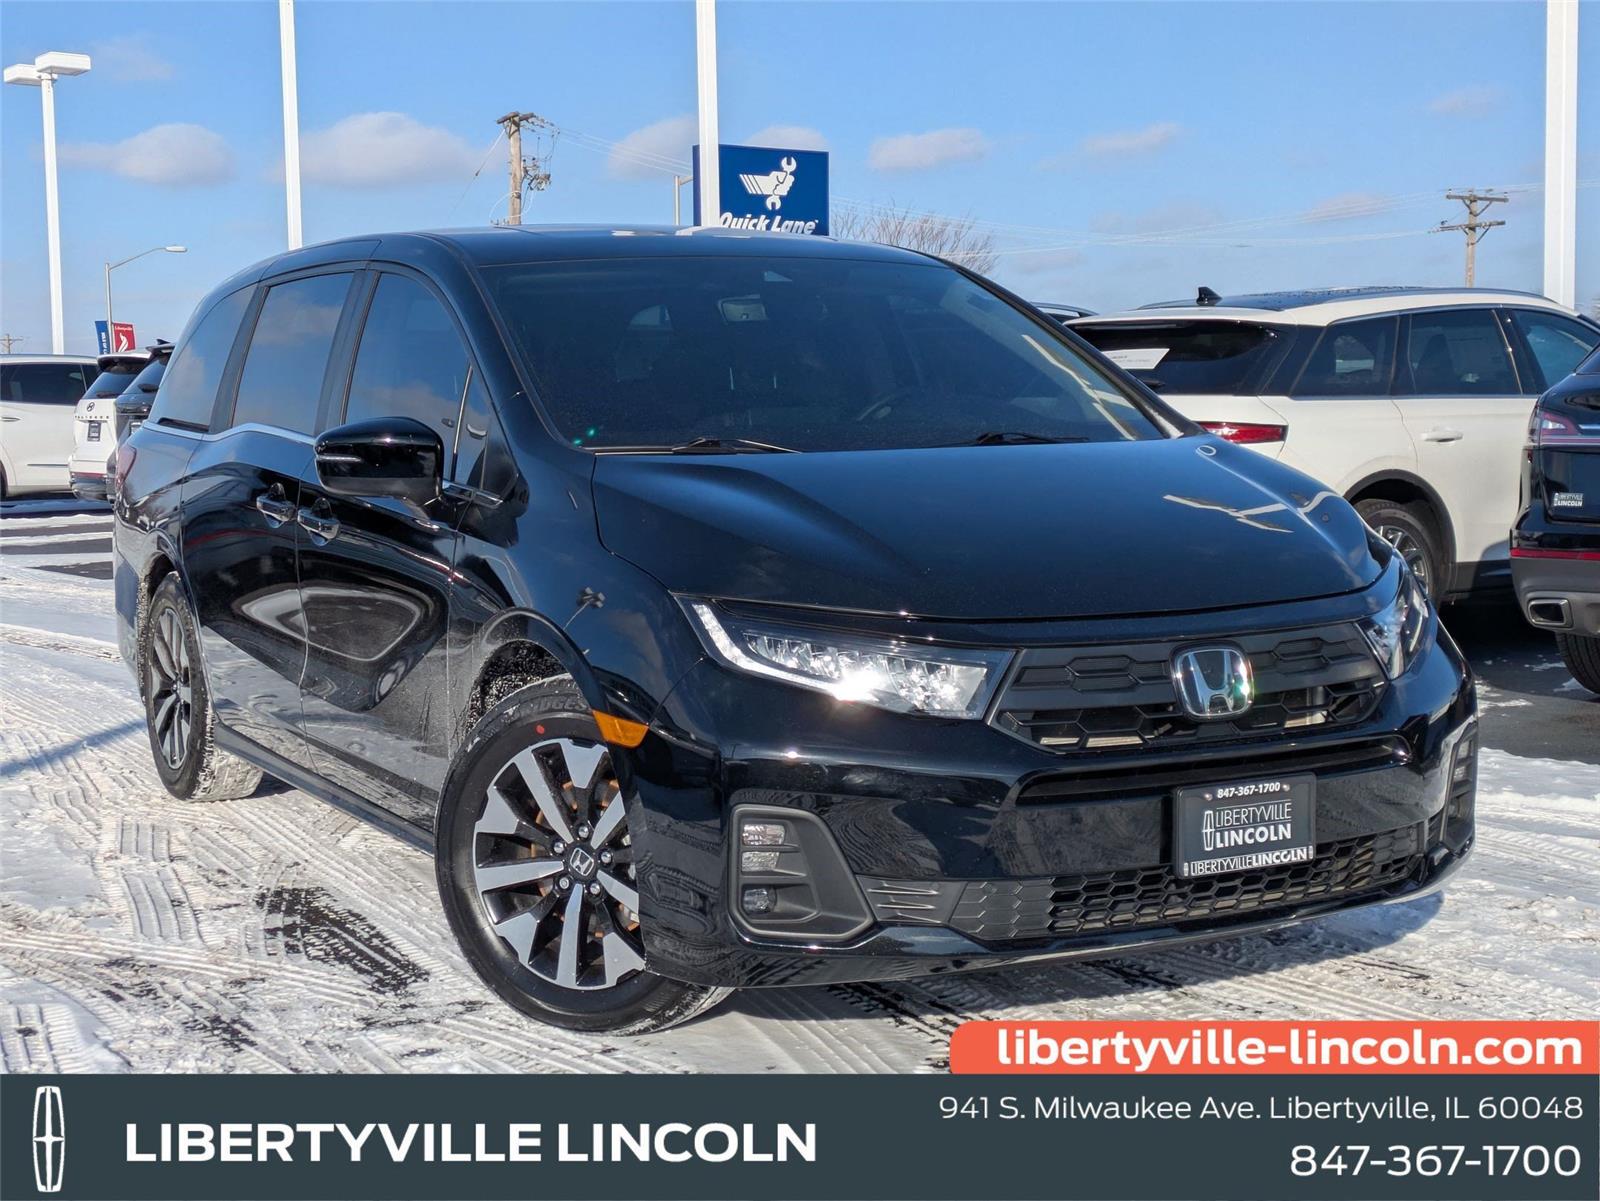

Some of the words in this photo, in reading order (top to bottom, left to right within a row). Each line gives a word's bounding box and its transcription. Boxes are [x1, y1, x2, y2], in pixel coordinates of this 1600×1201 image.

[720, 212, 770, 231] Quick
[771, 215, 816, 235] Lane
[1217, 782, 1281, 799] 847-367-1700
[1216, 802, 1292, 827] LIBERTYVILLE
[1216, 823, 1292, 848] LINCOLN
